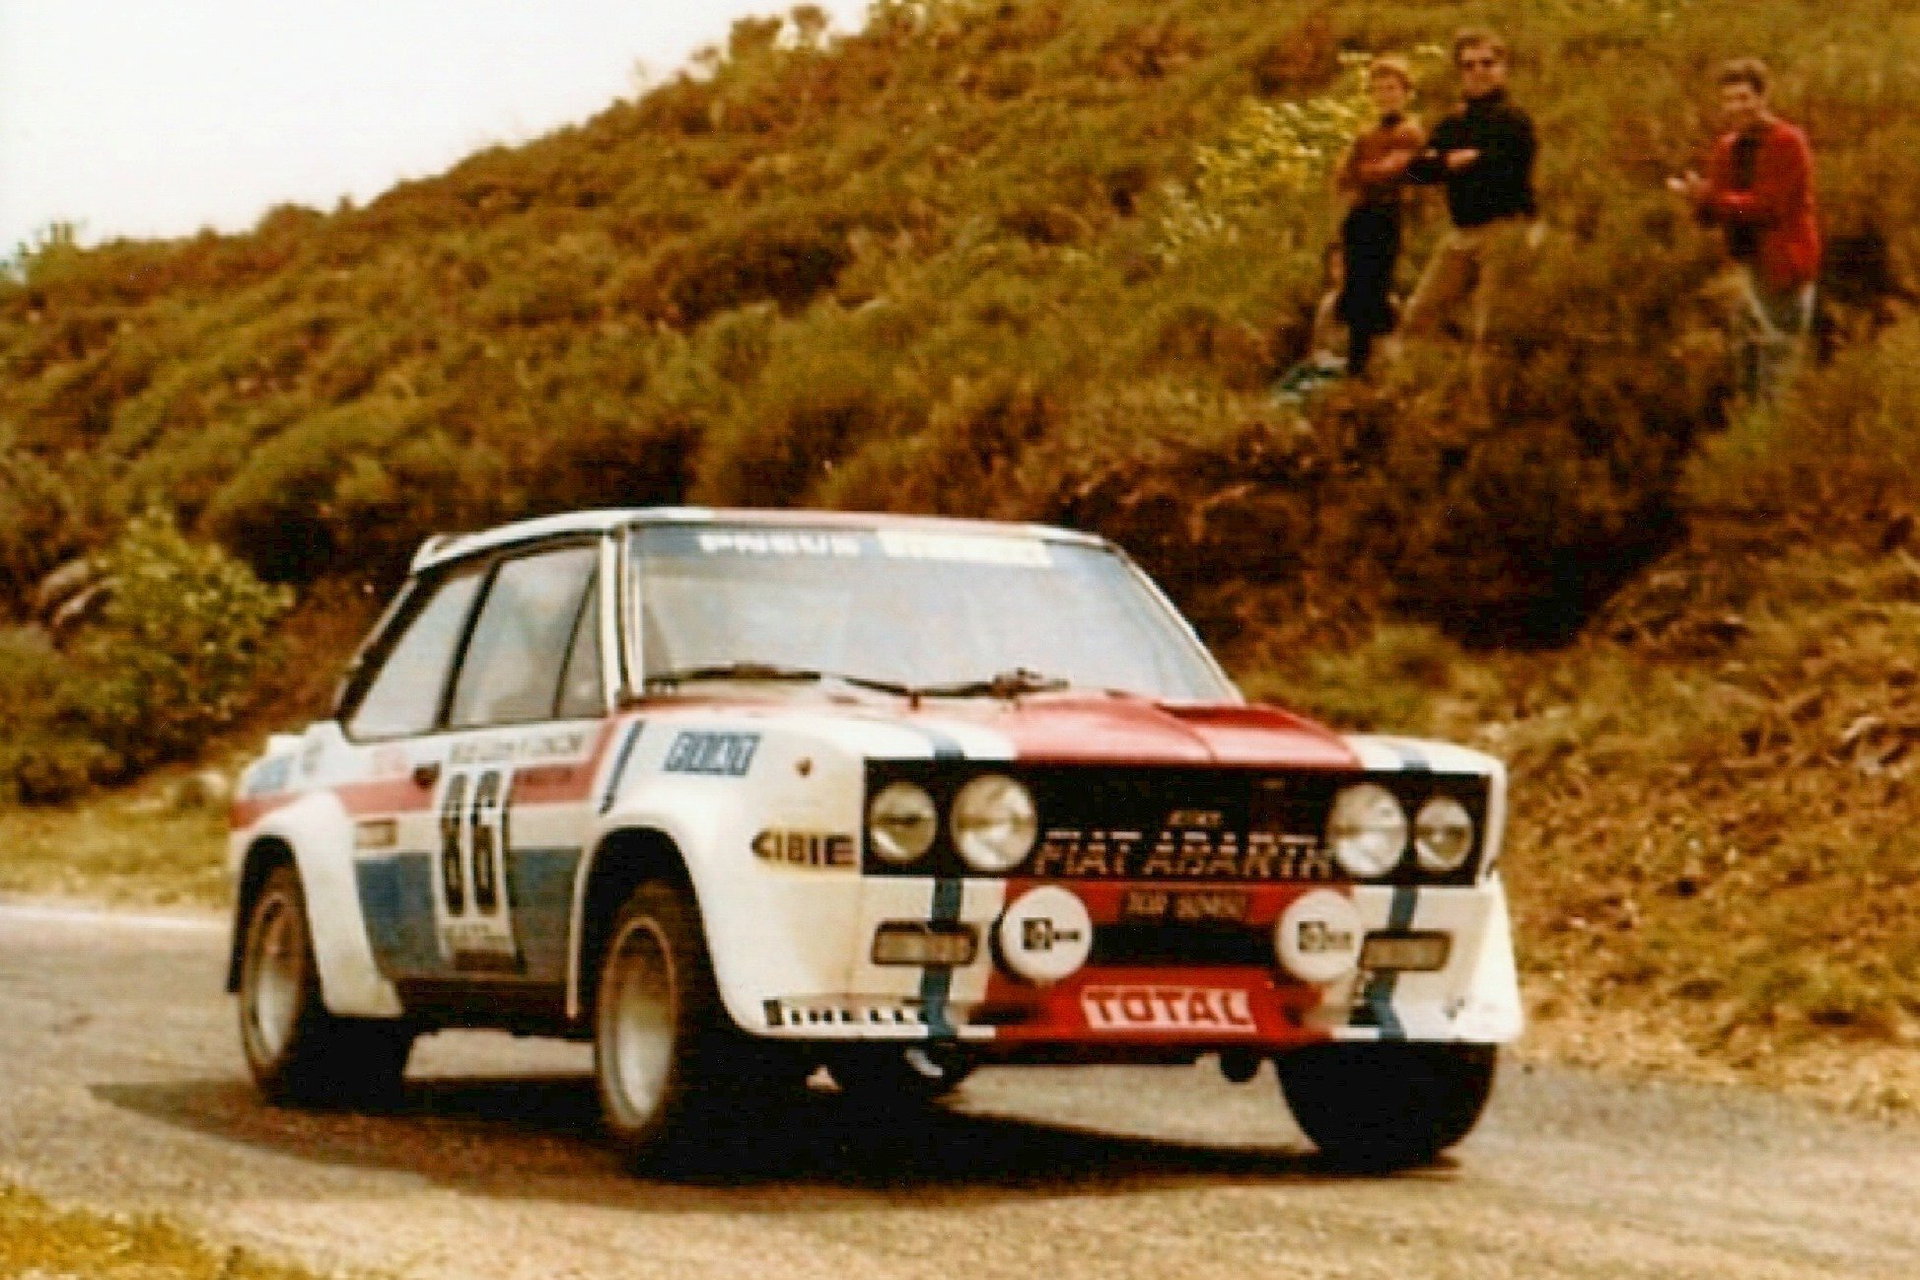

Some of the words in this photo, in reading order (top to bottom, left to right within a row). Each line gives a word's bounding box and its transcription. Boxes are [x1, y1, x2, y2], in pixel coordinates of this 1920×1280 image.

[751, 828, 855, 867] CIBIE
[1034, 831, 1143, 875] FIAT
[1141, 831, 1332, 879] ABARTH
[1085, 990, 1253, 1027] TOTAL
